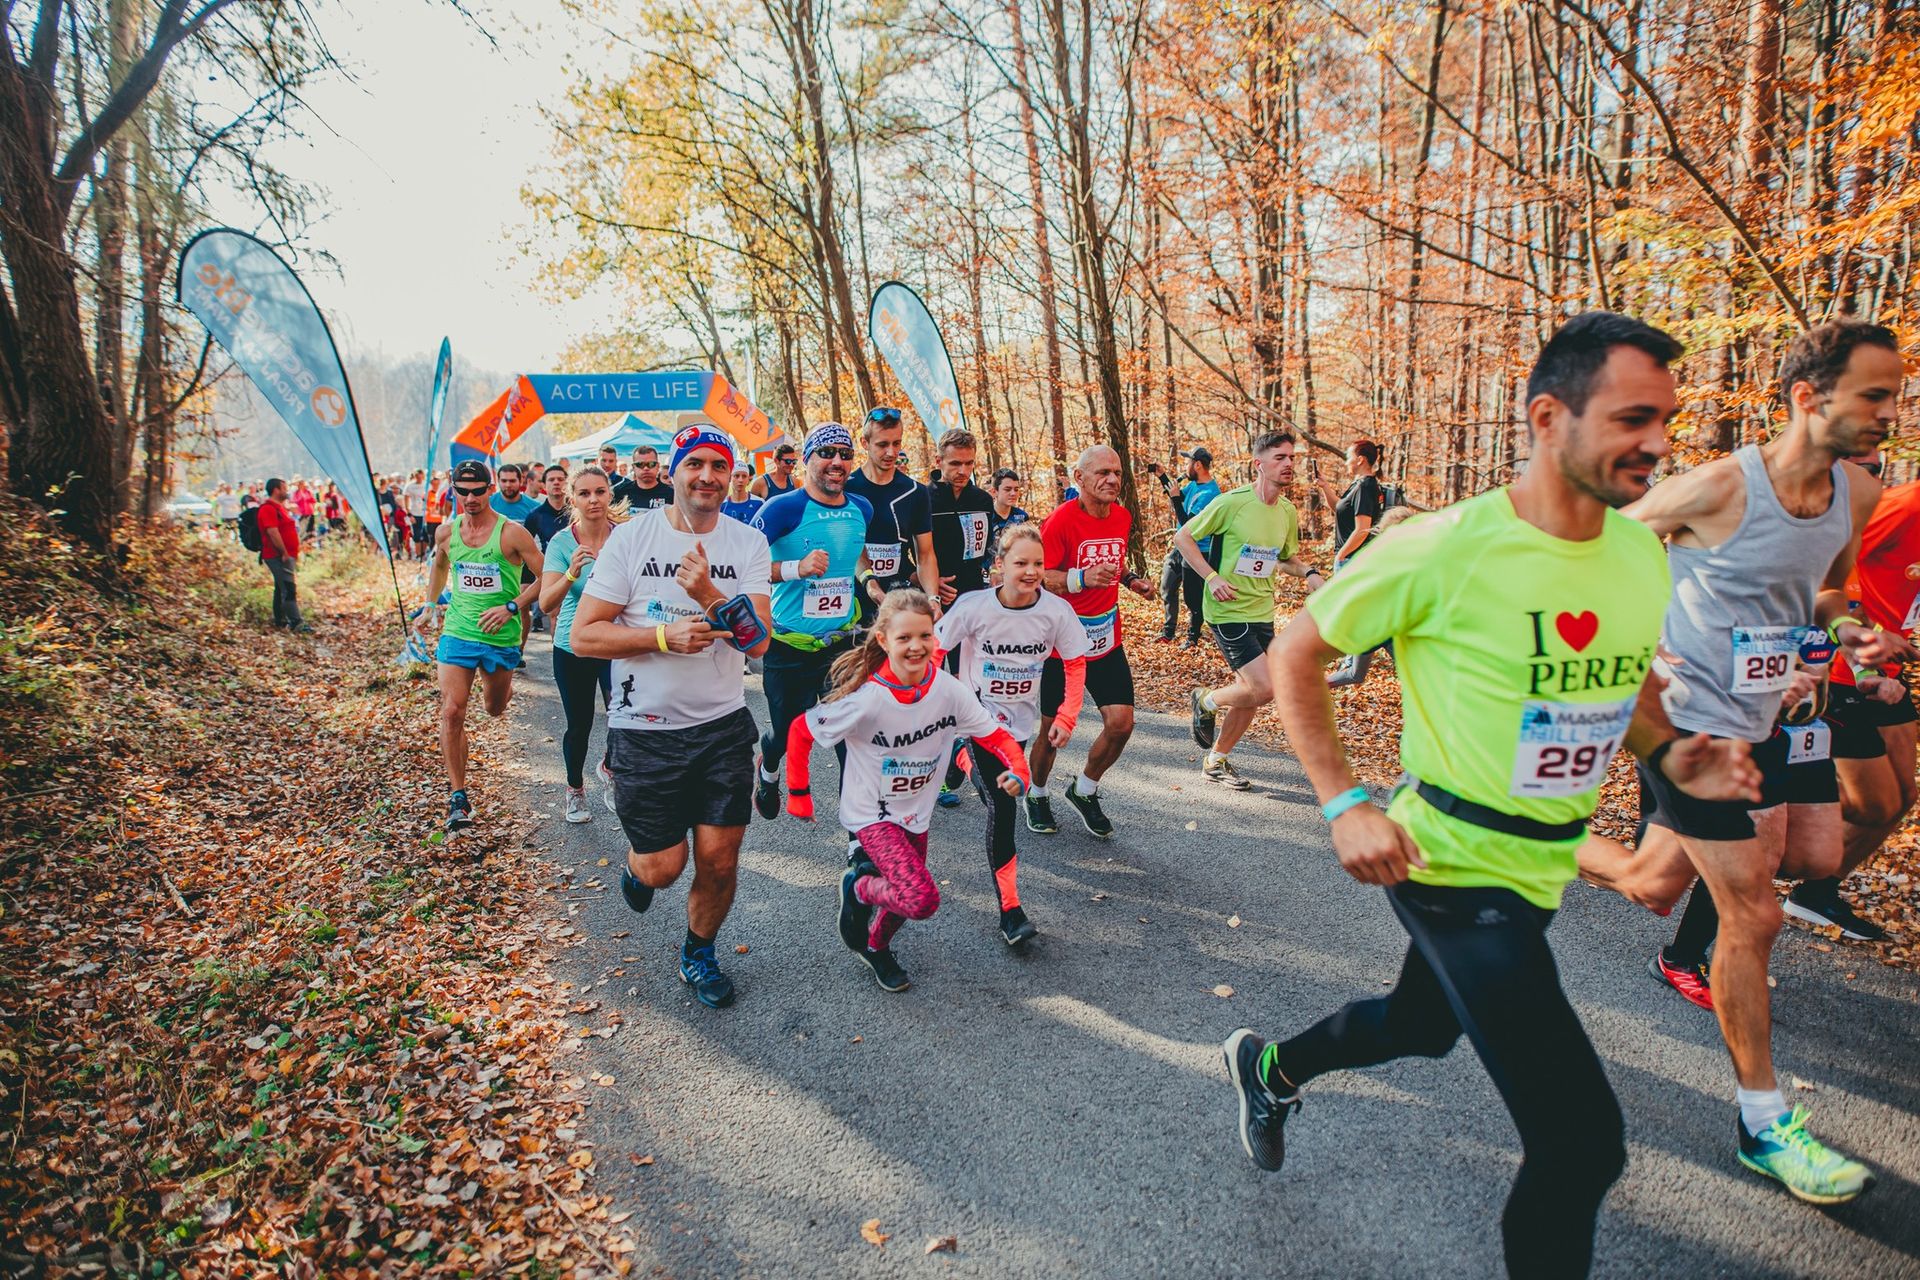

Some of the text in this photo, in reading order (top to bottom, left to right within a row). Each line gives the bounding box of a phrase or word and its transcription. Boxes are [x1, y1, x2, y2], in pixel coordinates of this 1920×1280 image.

[551, 380, 700, 401] ACTIVE LIFE
[974, 520, 984, 552] 266
[664, 563, 737, 580] MNA
[1253, 560, 1264, 572] 3
[463, 575, 495, 588] 302
[817, 581, 842, 590] MAGNA
[664, 604, 704, 617] MAGN
[818, 596, 843, 611] 24
[1524, 610, 1550, 658] I
[996, 665, 1029, 674] MAGNA
[1746, 654, 1789, 680] 290
[989, 680, 1032, 695] 259
[892, 714, 957, 748] MAGNA
[1803, 731, 1815, 751] 8
[1536, 739, 1615, 778] 291
